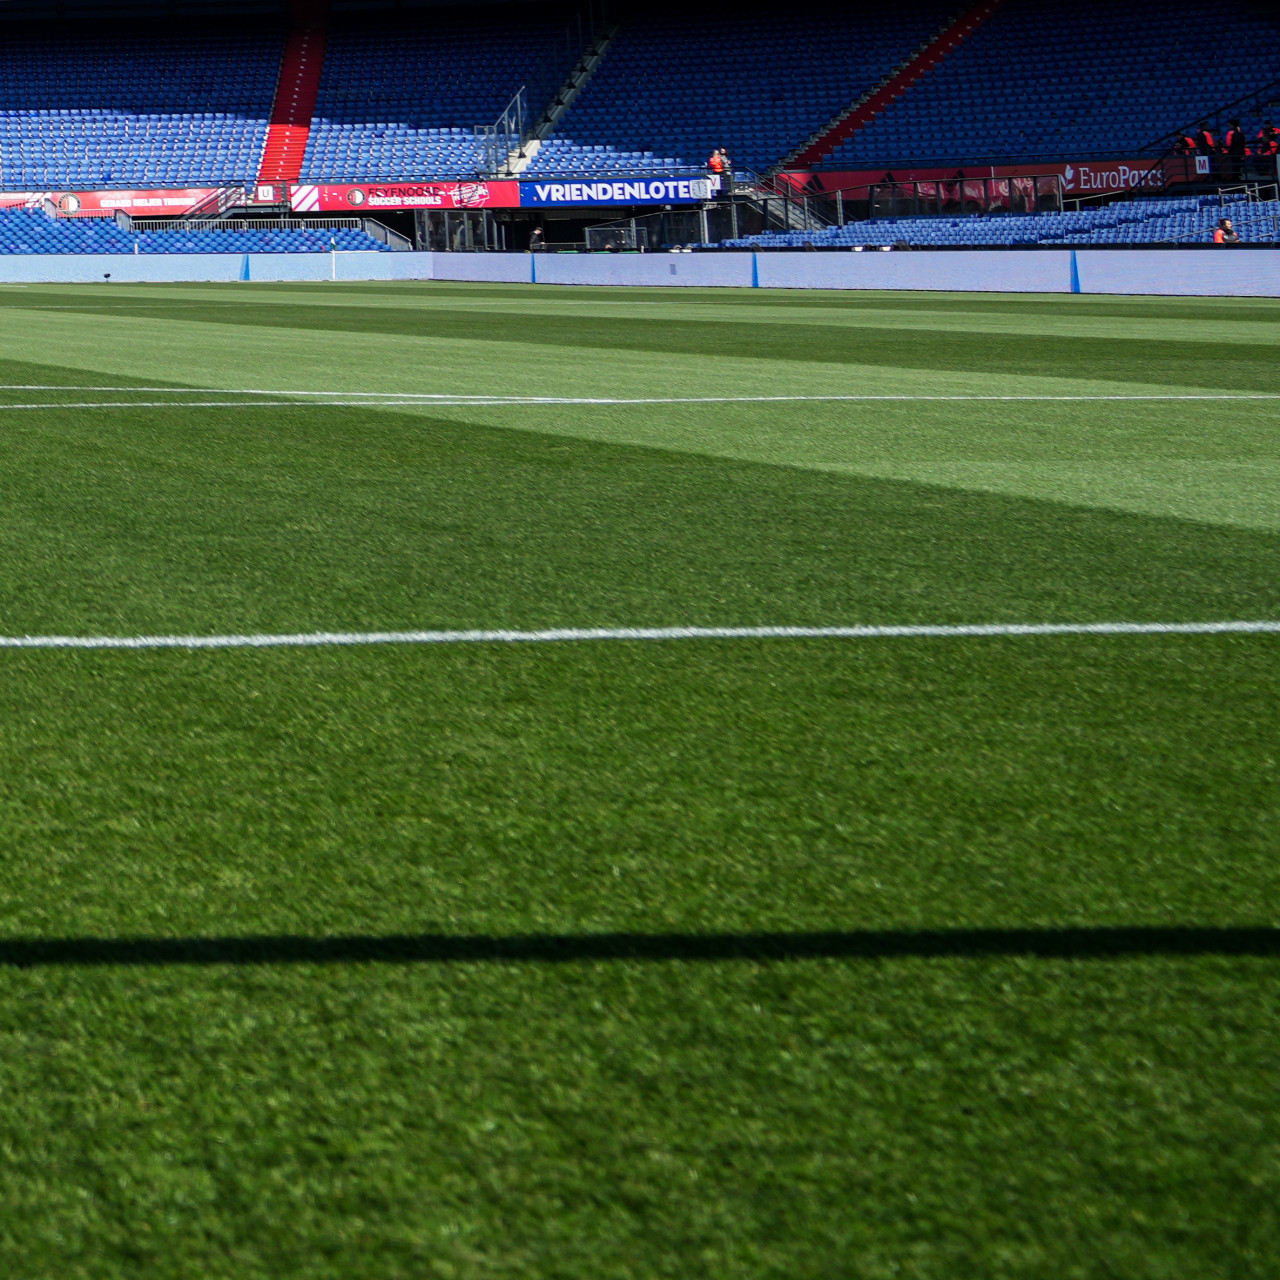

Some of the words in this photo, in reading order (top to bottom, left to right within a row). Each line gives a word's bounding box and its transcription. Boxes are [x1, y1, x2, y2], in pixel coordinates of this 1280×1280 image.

[1198, 159, 1207, 171] M
[1079, 166, 1166, 189] EuroParcs
[261, 188, 270, 199] U
[535, 181, 691, 201] VRIENDENLOTE
[100, 199, 132, 208] GERARD
[368, 196, 402, 207] SOCCER
[403, 195, 442, 206] SCHOOLS
